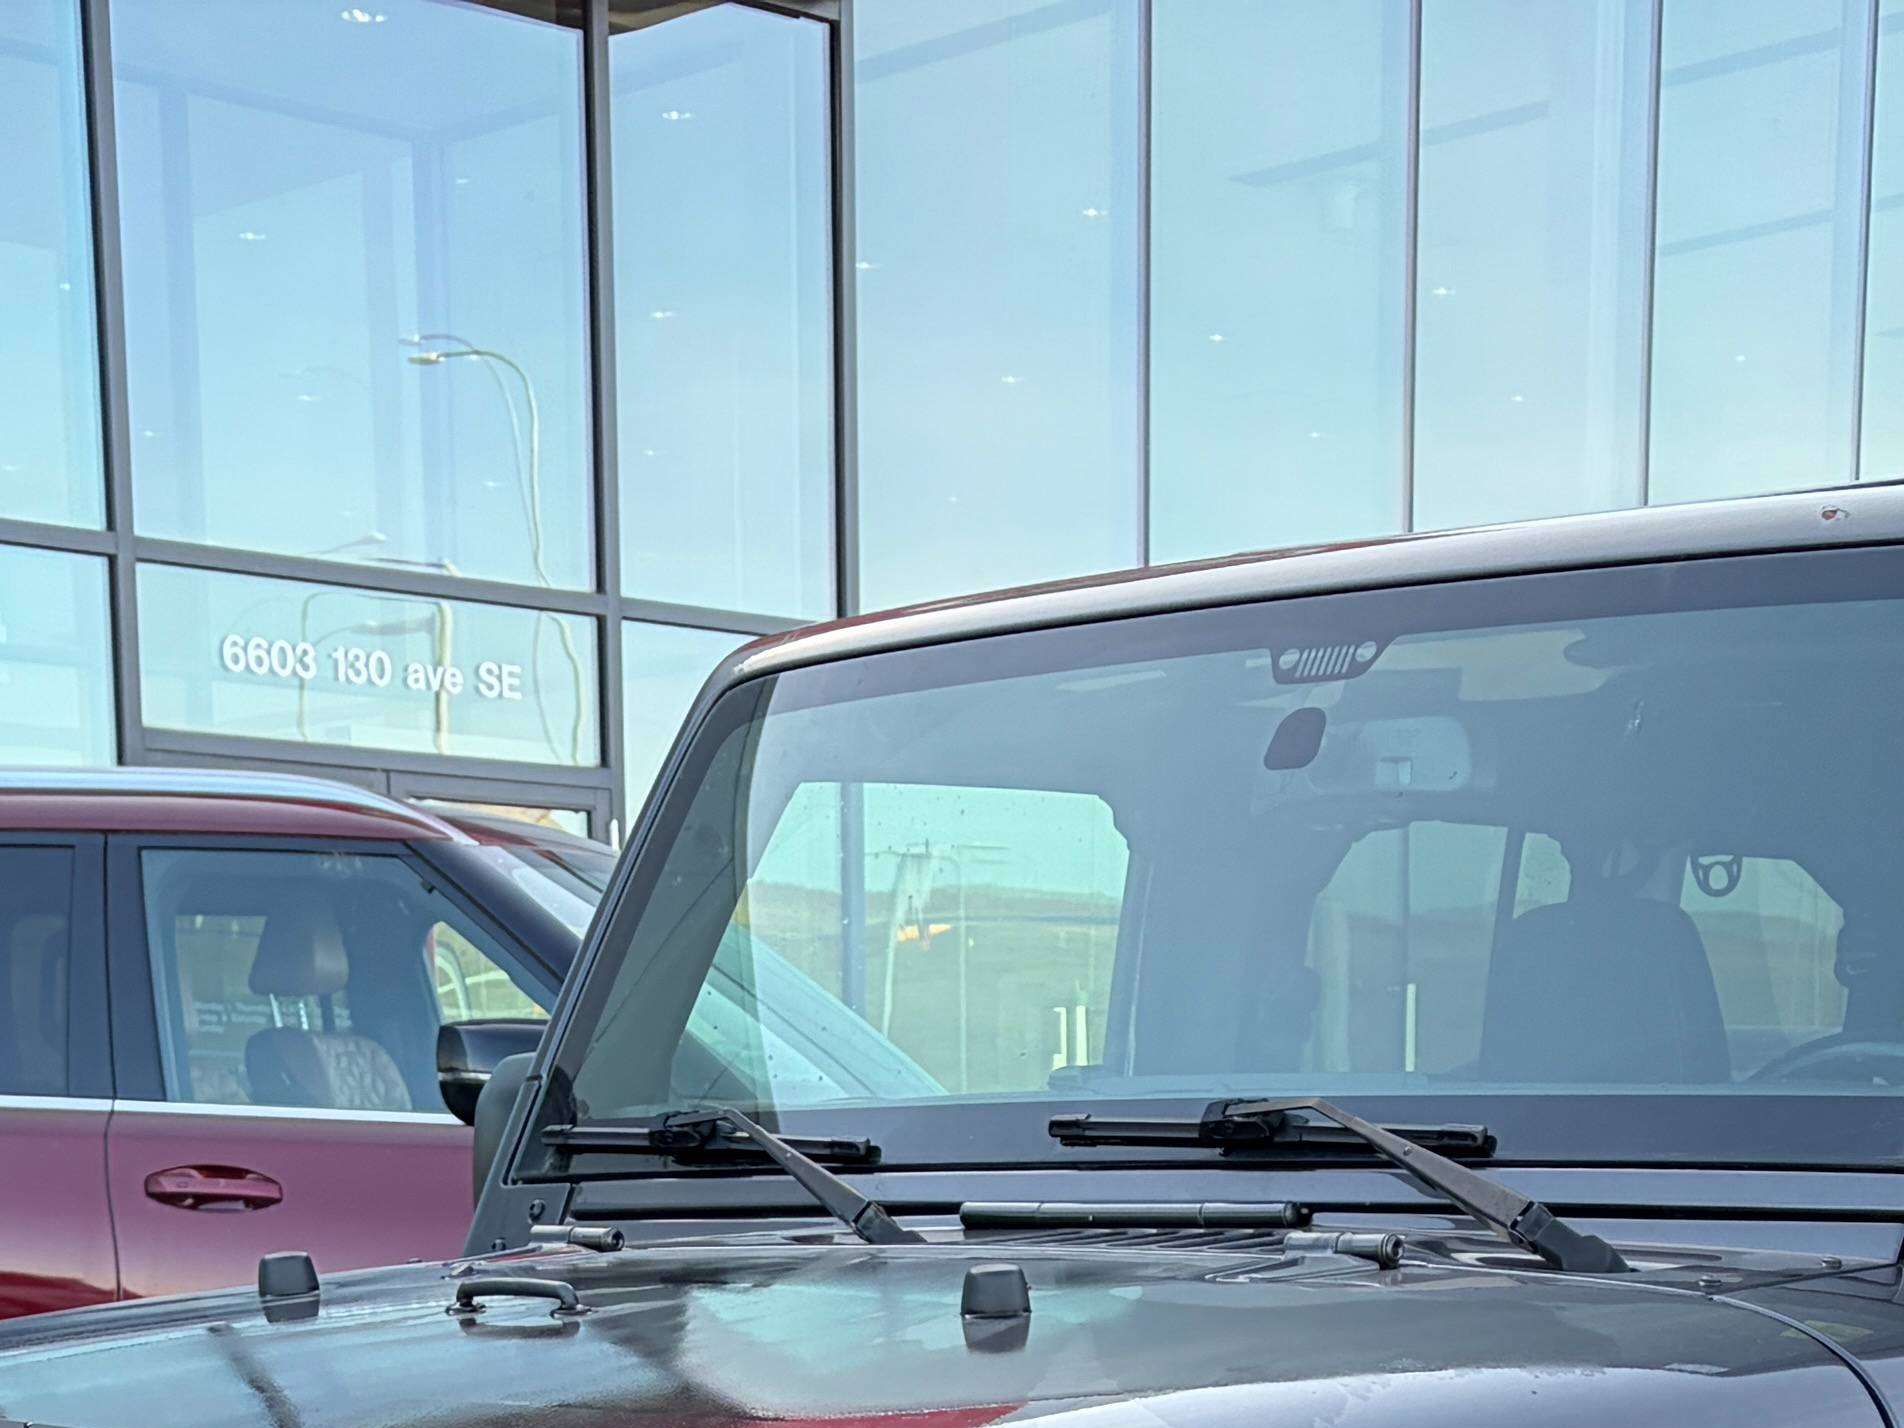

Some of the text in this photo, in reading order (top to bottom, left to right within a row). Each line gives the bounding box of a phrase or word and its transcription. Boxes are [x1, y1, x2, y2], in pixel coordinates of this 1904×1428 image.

[221, 634, 523, 700] 6603 130 ave SE
